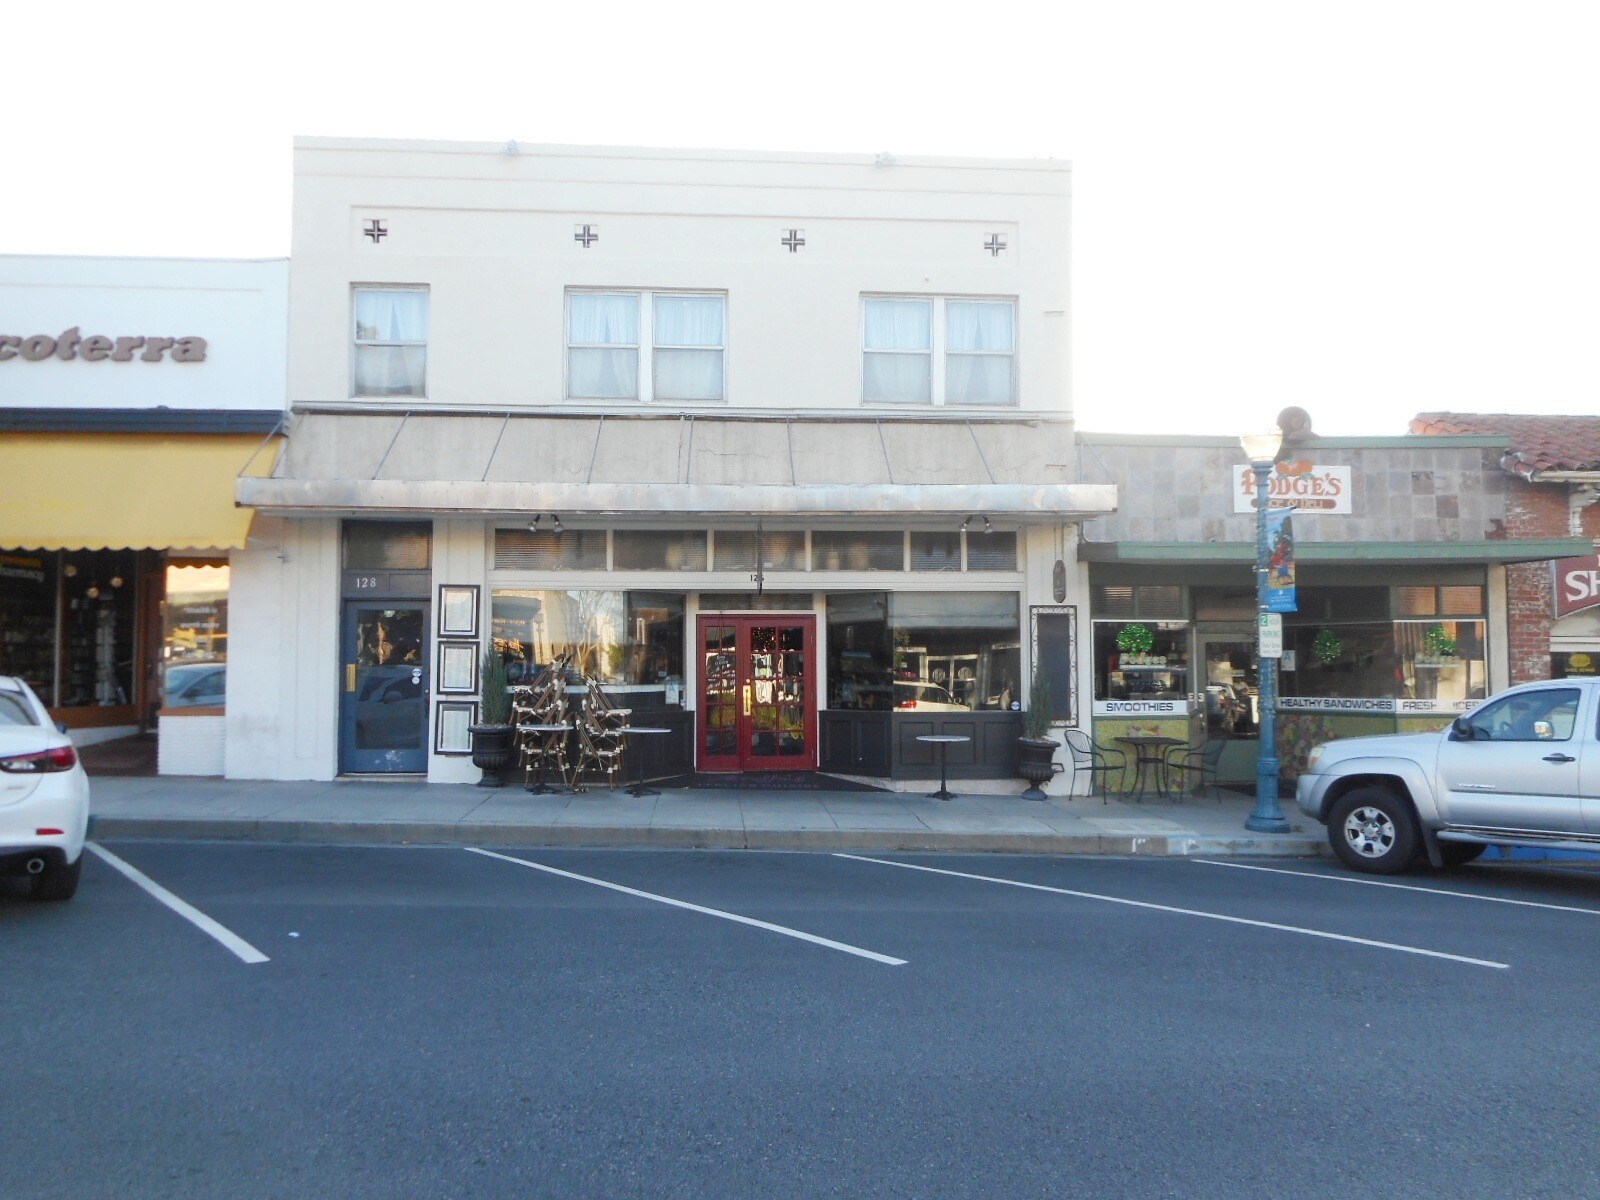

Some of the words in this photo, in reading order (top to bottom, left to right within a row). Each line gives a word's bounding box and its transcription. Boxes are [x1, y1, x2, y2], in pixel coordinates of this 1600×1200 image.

[0, 326, 208, 362] coterra
[355, 577, 376, 588] 128
[1260, 615, 1268, 626] 2
[1106, 702, 1174, 712] SMOOTHIES
[1280, 698, 1321, 708] HEALTHY
[1324, 699, 1392, 710] SANDWICHES
